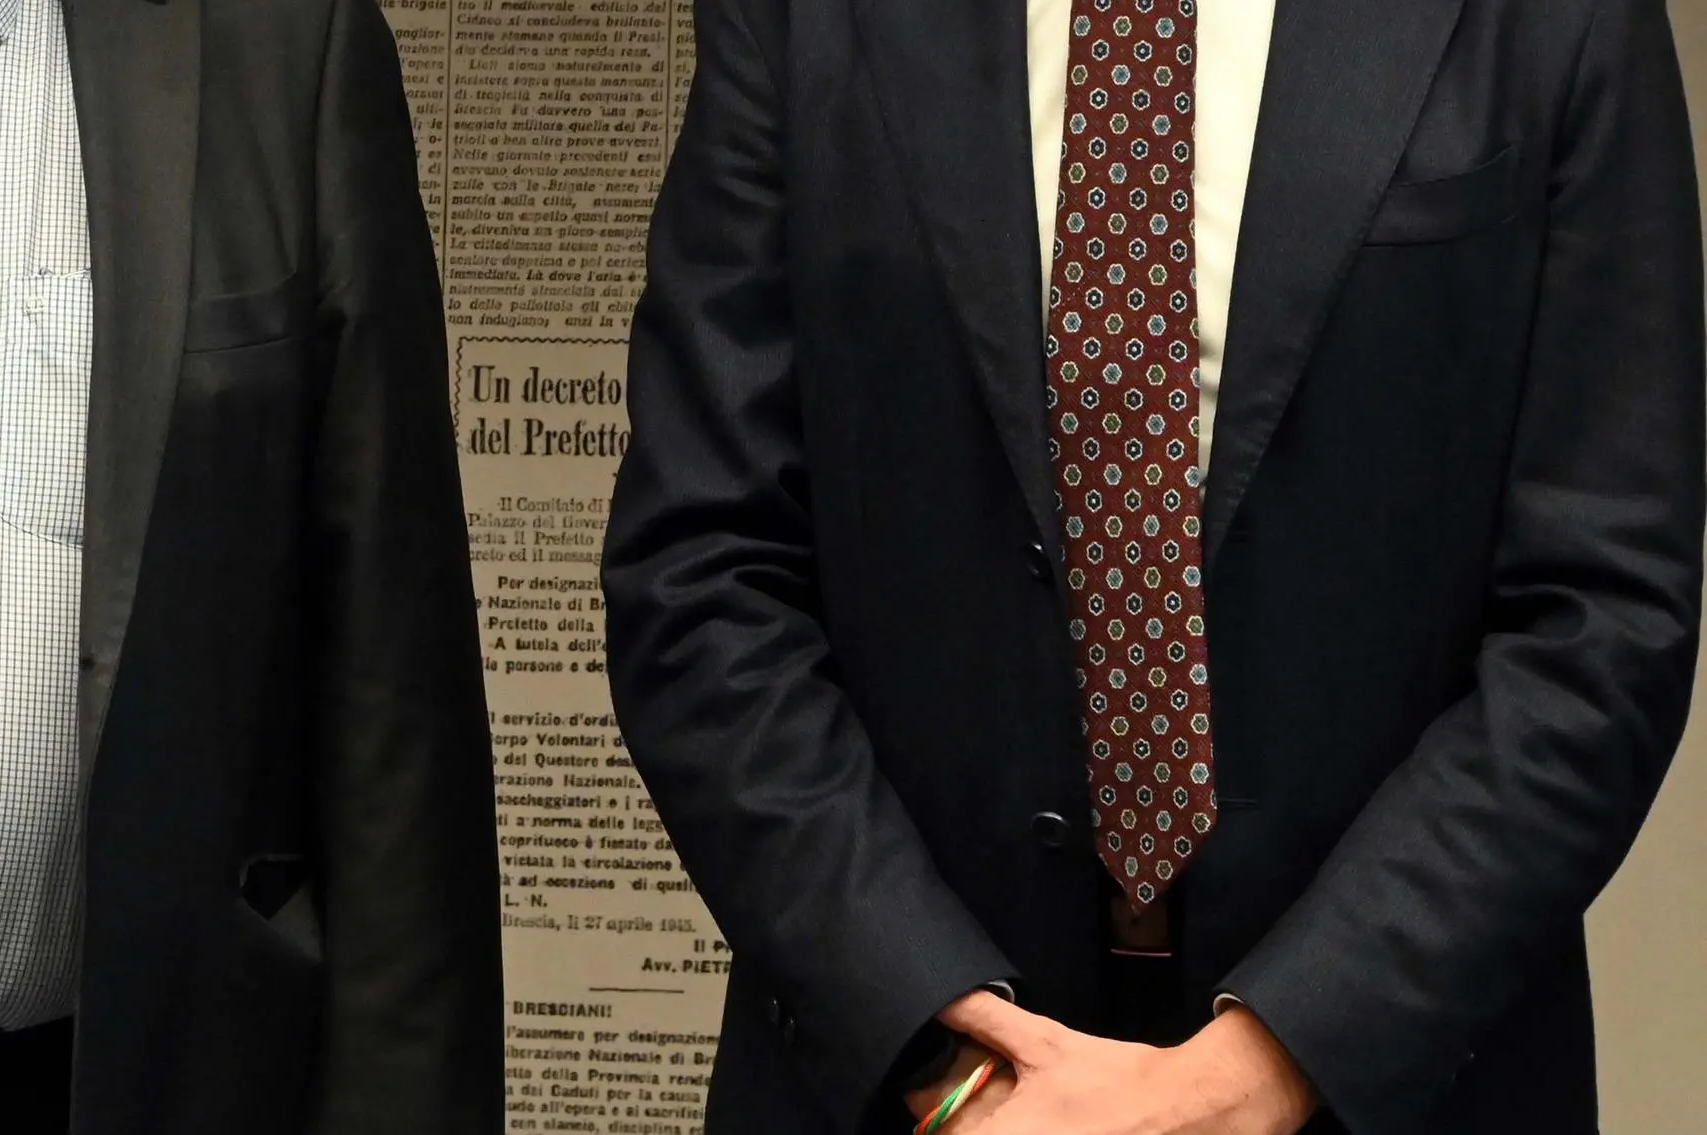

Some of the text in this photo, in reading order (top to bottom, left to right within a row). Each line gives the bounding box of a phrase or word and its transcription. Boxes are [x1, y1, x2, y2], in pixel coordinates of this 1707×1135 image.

[473, 365, 622, 405] Un decreto
[469, 417, 631, 457] del Prefetto
[516, 497, 585, 513] Comitato
[588, 497, 603, 513] di
[533, 531, 595, 546] Prefetto
[548, 550, 602, 566] messag
[497, 576, 524, 590] Per
[487, 597, 582, 611] Nazionale di
[488, 616, 594, 632] Prefetto della
[494, 637, 507, 650] A
[505, 660, 579, 674] persone e
[503, 713, 561, 726] servizio
[536, 733, 606, 747] Volontari
[503, 753, 599, 768] del Questore
[496, 794, 601, 810] saccheggiatori
[532, 816, 625, 830] norma delle
[500, 836, 579, 853] coprifuoco
[600, 836, 648, 851] fissato
[504, 855, 673, 872] vietata la circolazione
[518, 875, 695, 894] ad di quell
[504, 894, 548, 907] L. N.
[584, 916, 602, 931] 27
[606, 916, 653, 935] aprile
[641, 958, 677, 974] Avv.
[512, 1000, 613, 1018] BRESCIANI!
[593, 1030, 620, 1044] per
[588, 1048, 685, 1065] Nazionale di
[542, 1067, 660, 1086] della Provincia
[606, 1088, 632, 1103] per
[638, 1087, 653, 1102] la
[659, 1090, 701, 1104] causa
